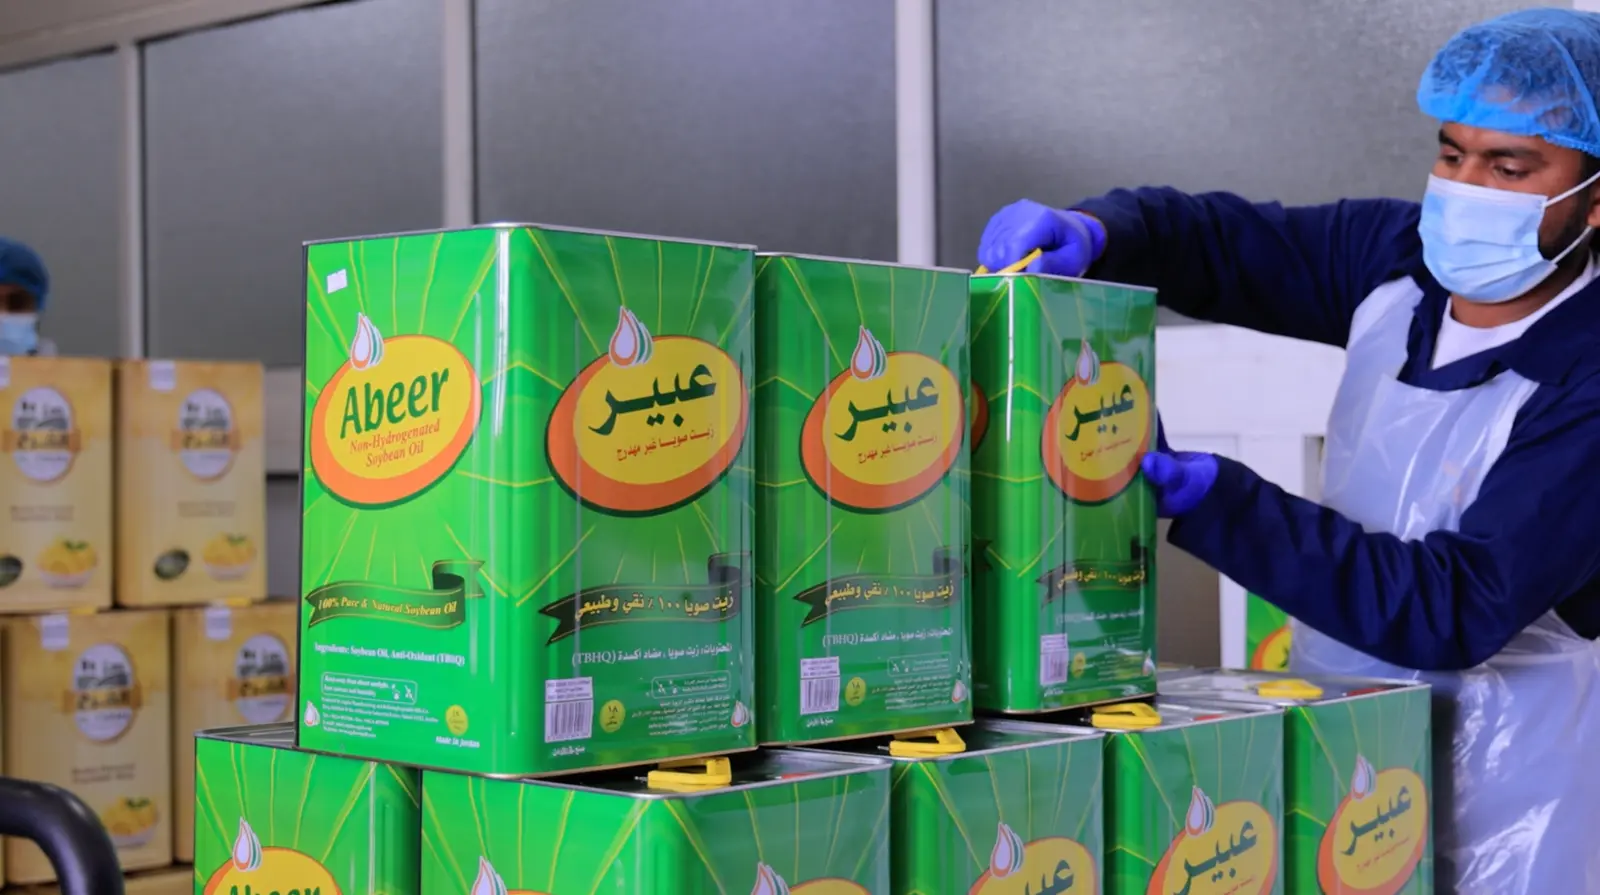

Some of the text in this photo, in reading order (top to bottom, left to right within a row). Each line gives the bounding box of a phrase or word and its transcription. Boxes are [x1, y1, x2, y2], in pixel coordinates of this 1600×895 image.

[340, 368, 449, 439] Abeer
[588, 363, 717, 436] عبير
[834, 377, 939, 442] عبير
[1064, 383, 1135, 441] عبير
[350, 418, 440, 454] Non-Hydrogenated
[659, 434, 688, 449] صويا
[690, 425, 714, 440] زيت
[366, 440, 424, 468] Soybean Oil
[644, 438, 657, 455] غير
[864, 582, 882, 601] نقي
[914, 588, 935, 604] صويا
[936, 580, 954, 599] زيت
[317, 597, 457, 617] 100% Pure & Natural Soybean Oil
[622, 593, 645, 615] نقي
[684, 600, 710, 617] صويا
[712, 590, 734, 612] زيت
[571, 650, 617, 667] (TBHQ)
[1340, 785, 1411, 856] عبير
[1172, 820, 1258, 895] عبير
